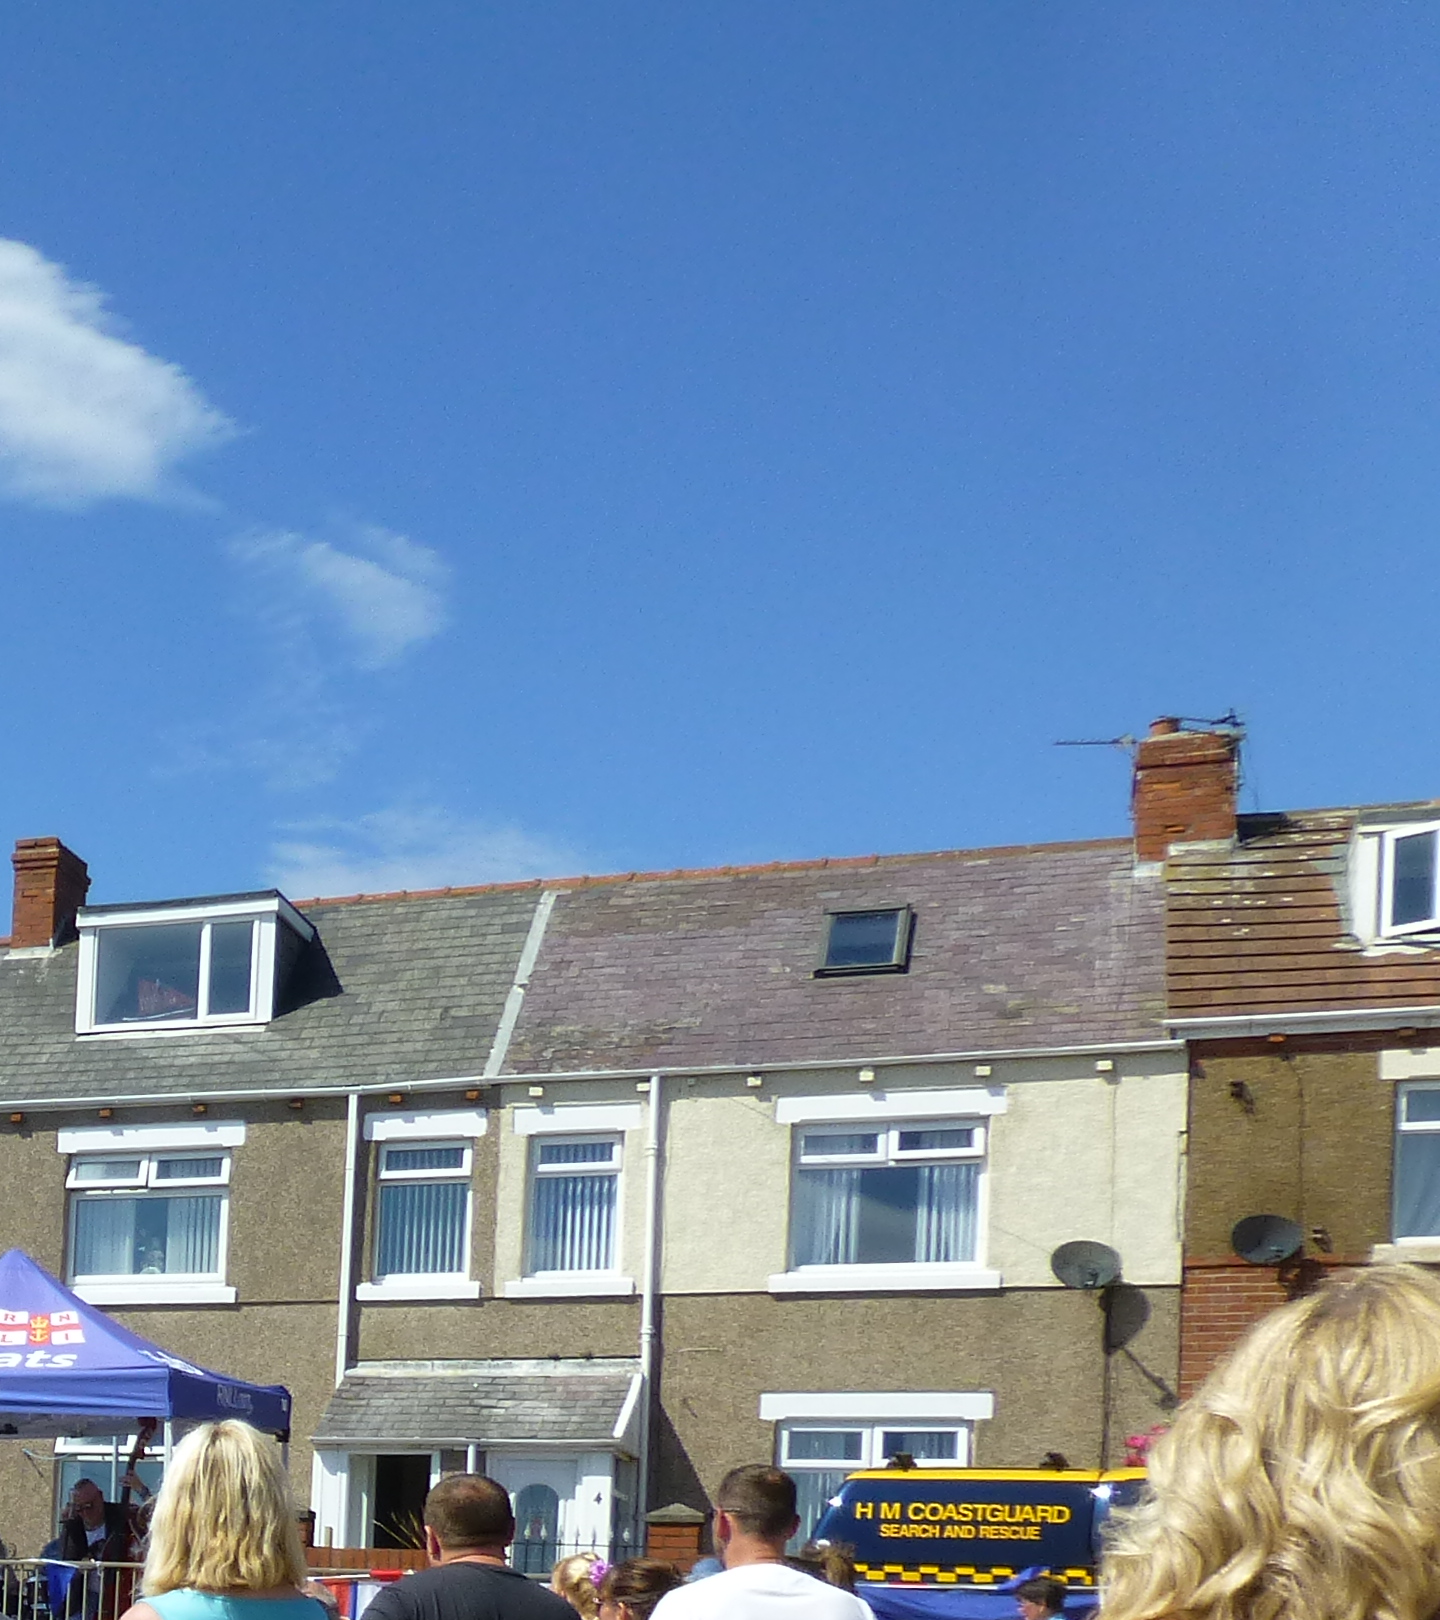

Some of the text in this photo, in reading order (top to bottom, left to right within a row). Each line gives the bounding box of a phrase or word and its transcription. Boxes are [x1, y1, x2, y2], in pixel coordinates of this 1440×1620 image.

[3, 1313, 71, 1322] R N
[855, 1502, 1071, 1523] H M COASTGUARD
[879, 1523, 1042, 1540] SEARCH AND RESCUE
